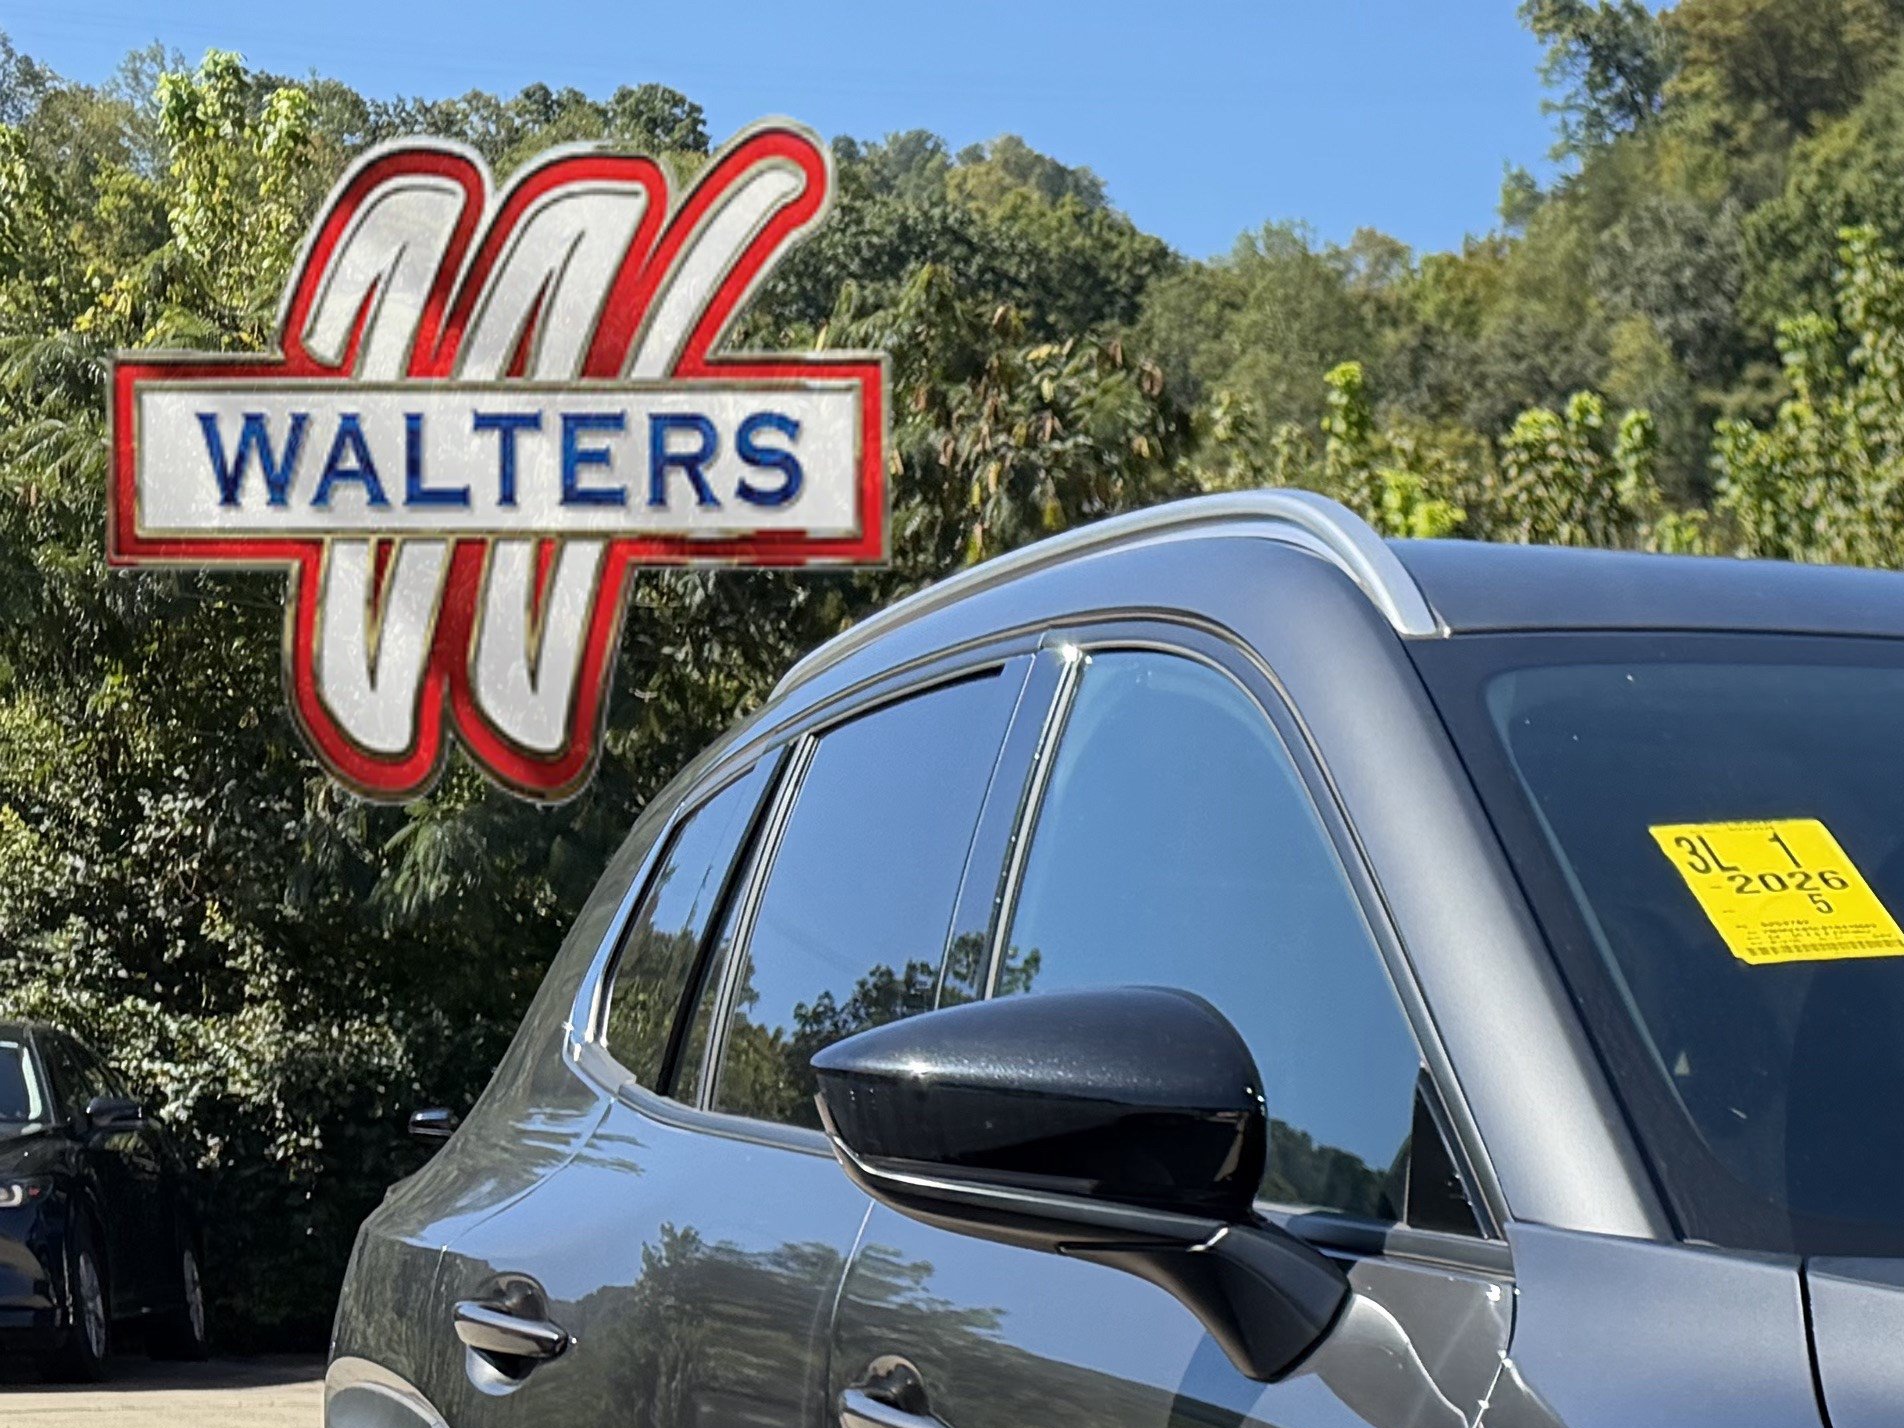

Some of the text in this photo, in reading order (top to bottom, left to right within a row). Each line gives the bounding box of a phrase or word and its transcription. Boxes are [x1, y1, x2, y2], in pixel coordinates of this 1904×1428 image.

[1674, 833, 1740, 875] 3L
[1727, 869, 1849, 895] 2026
[1808, 892, 1834, 914] 5
